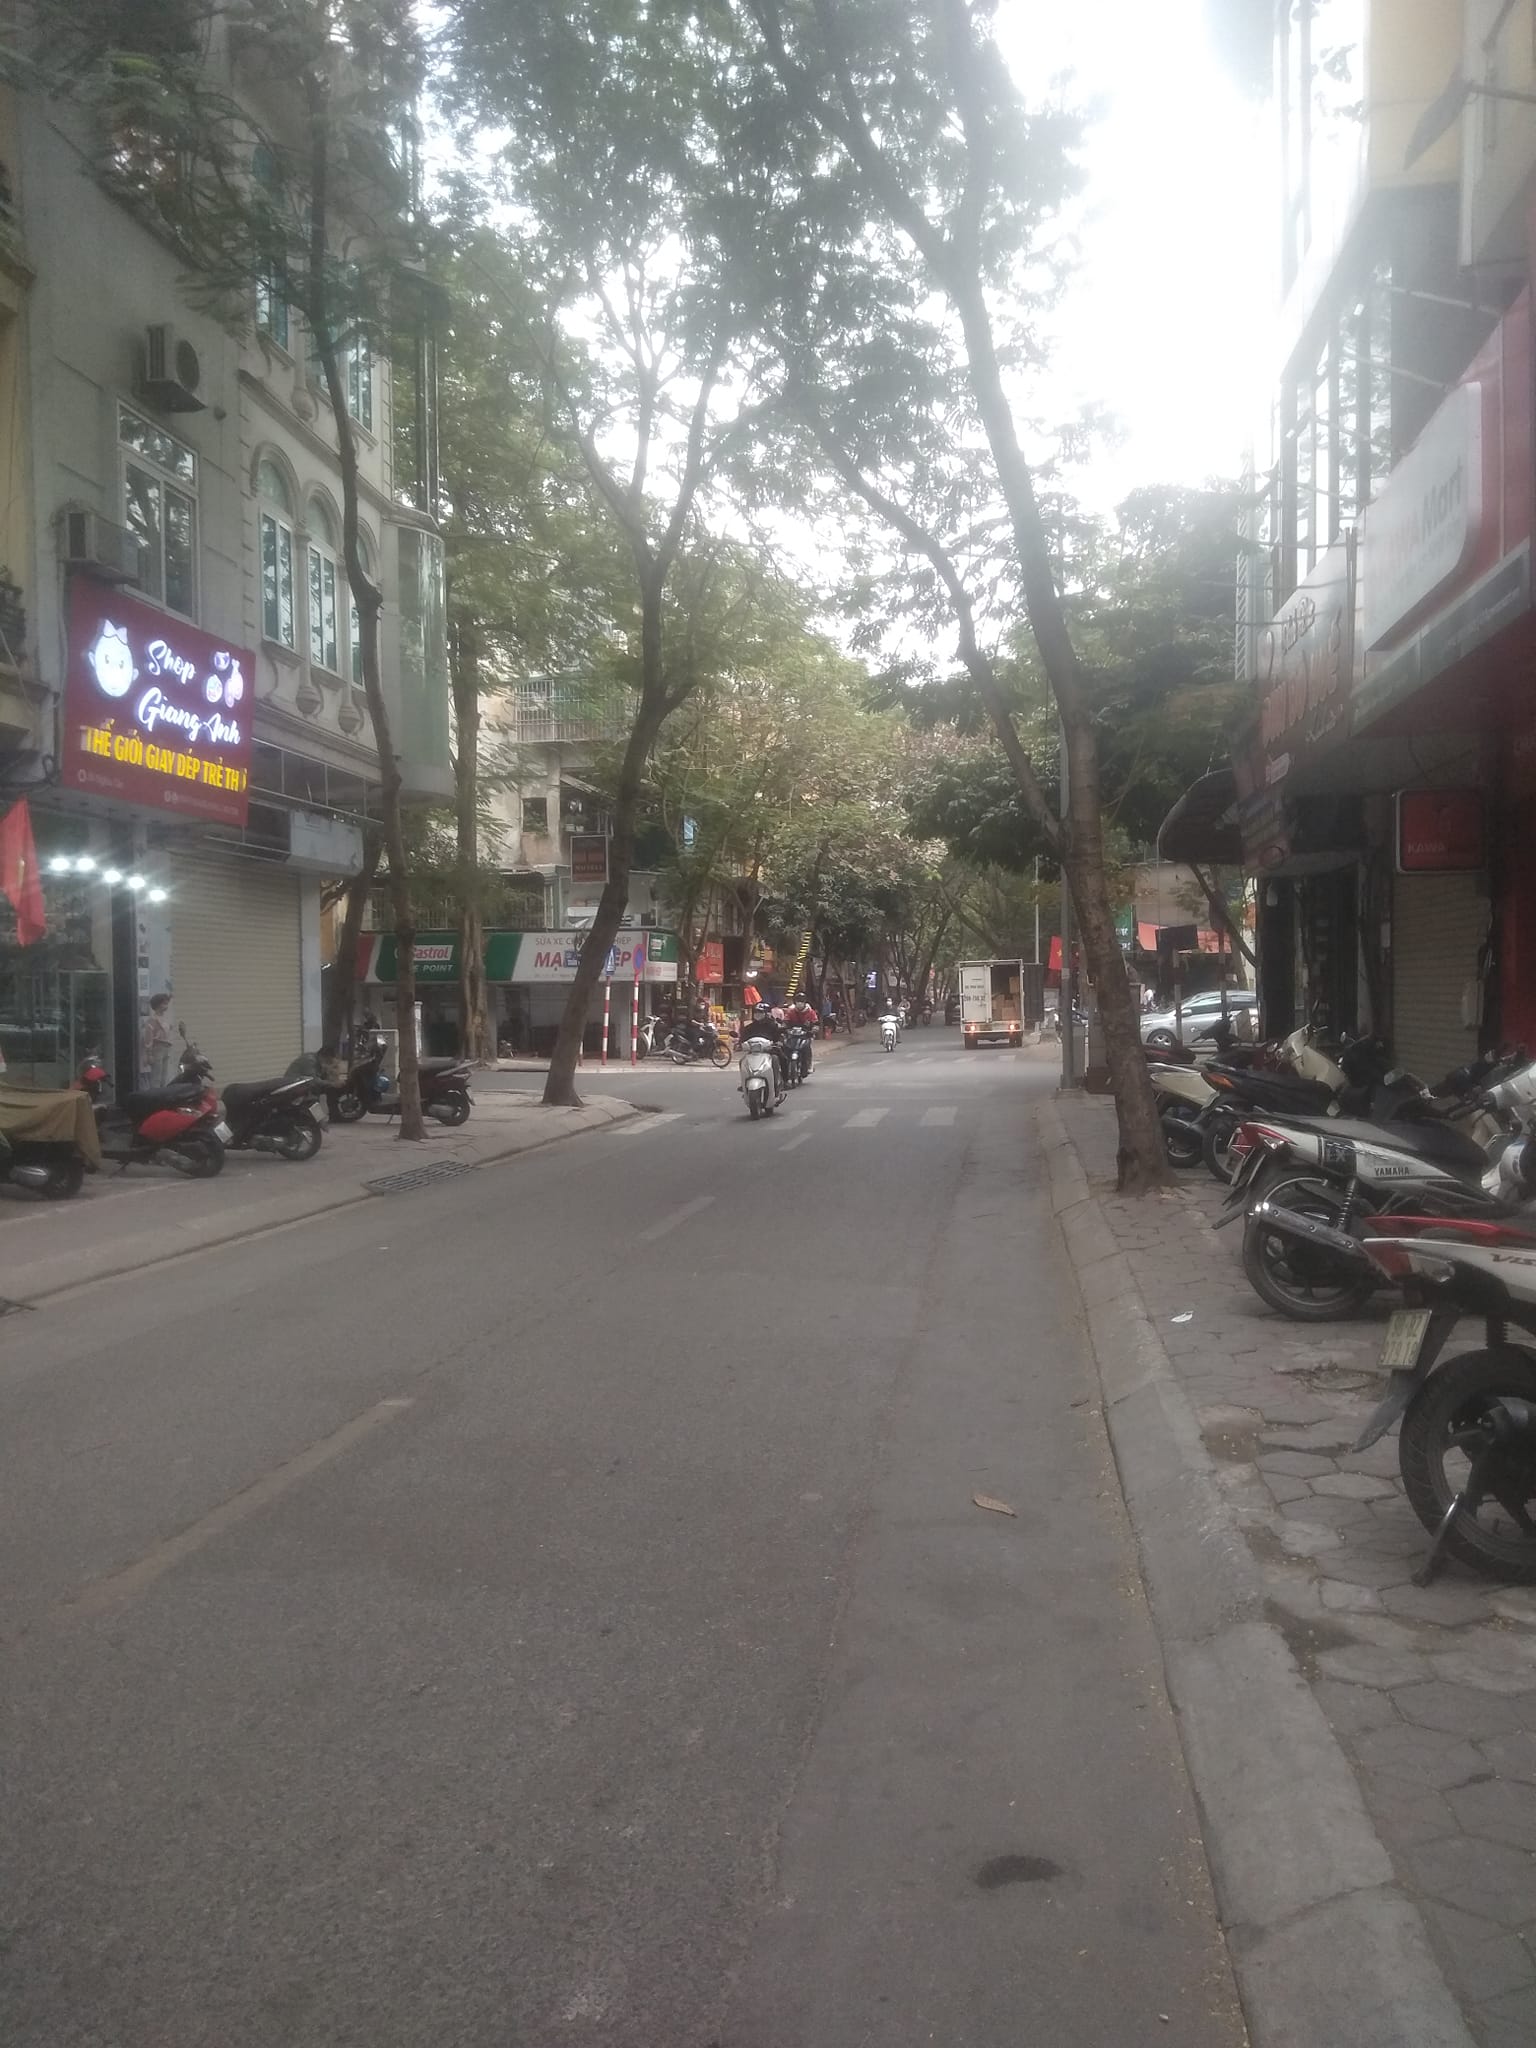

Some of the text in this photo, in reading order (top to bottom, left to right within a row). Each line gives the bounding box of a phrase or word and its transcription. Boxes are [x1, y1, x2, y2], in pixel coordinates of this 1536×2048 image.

[148, 639, 196, 684] Shop
[138, 686, 240, 745] Giang Anh
[422, 963, 454, 973] POINT
[1374, 1166, 1410, 1176] YAMAHA
